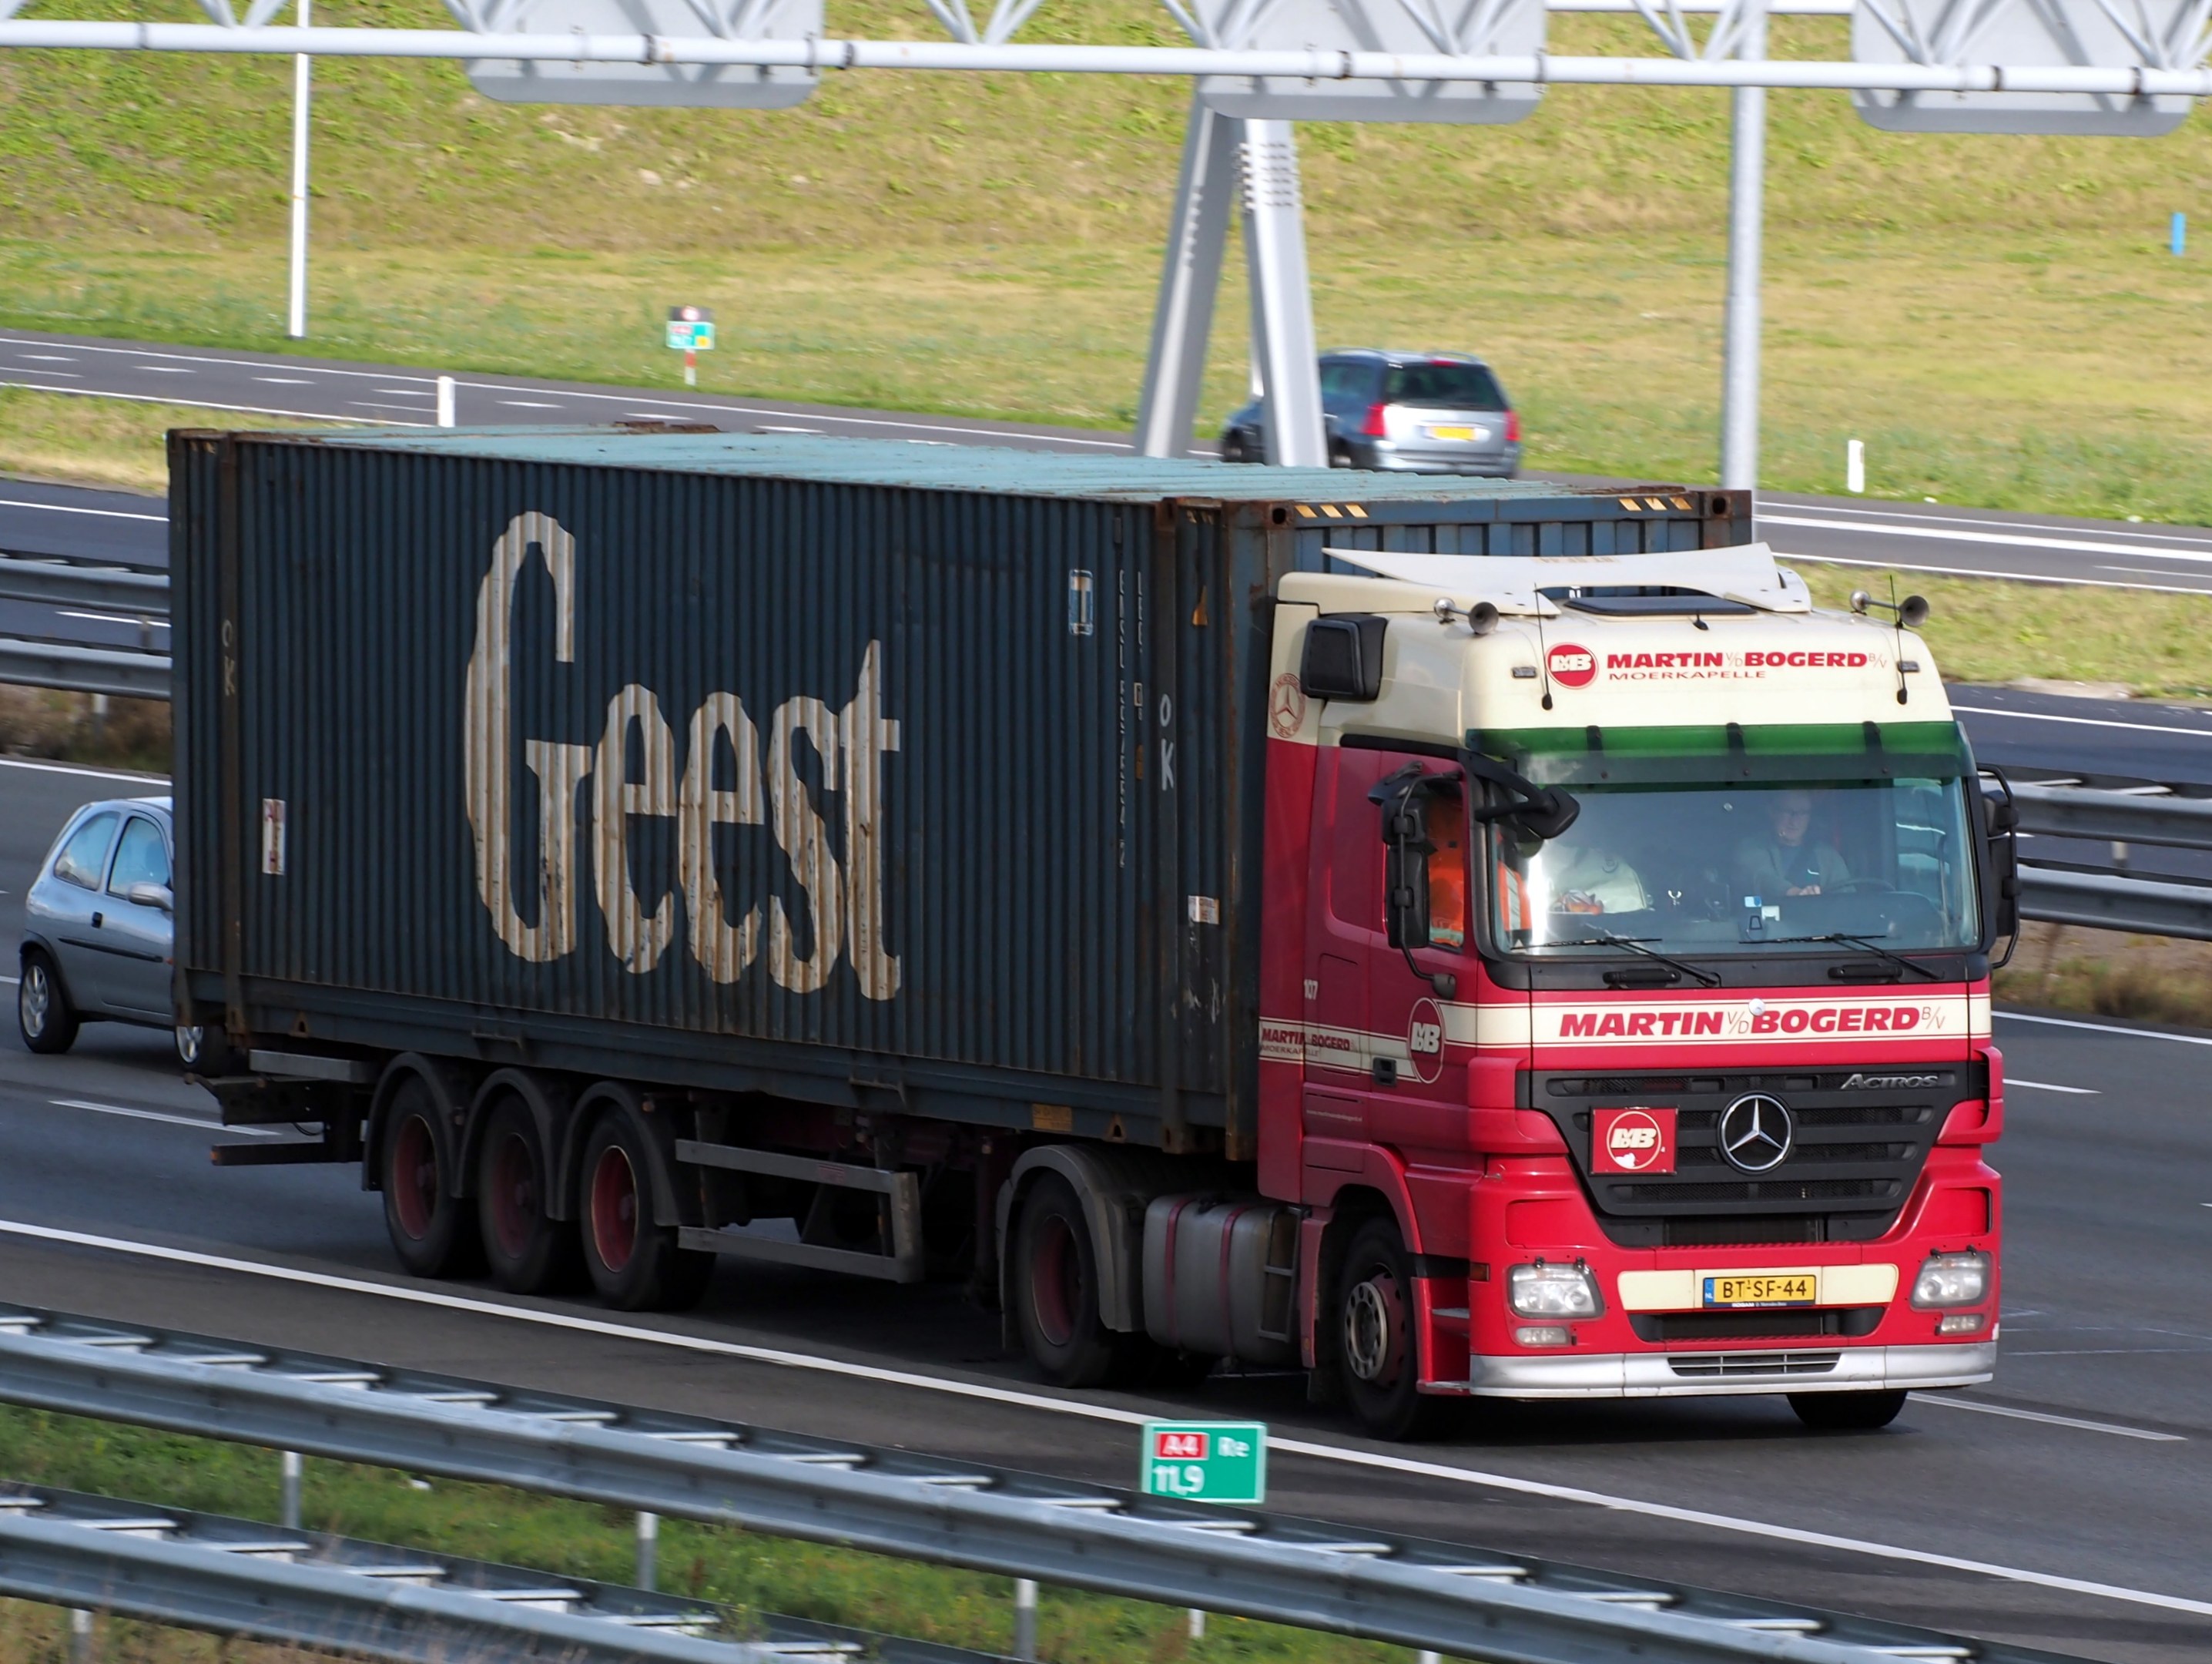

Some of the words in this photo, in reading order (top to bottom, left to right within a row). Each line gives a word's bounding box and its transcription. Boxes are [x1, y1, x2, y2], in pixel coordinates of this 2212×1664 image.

[1607, 653, 1723, 669] MARTIN
[1744, 652, 1868, 667] BOGERD
[1609, 671, 1766, 680] MOERKAPELLE
[465, 511, 900, 1001] Geest
[1303, 979, 1319, 1000] 107
[1559, 1011, 1724, 1037] MARTIN
[1751, 1007, 1921, 1034] BOGERD
[1312, 1034, 1350, 1052] BOGERD
[1723, 1280, 1807, 1299] BT-SF-44
[1162, 1435, 1199, 1456] A4
[1218, 1437, 1251, 1458] Re
